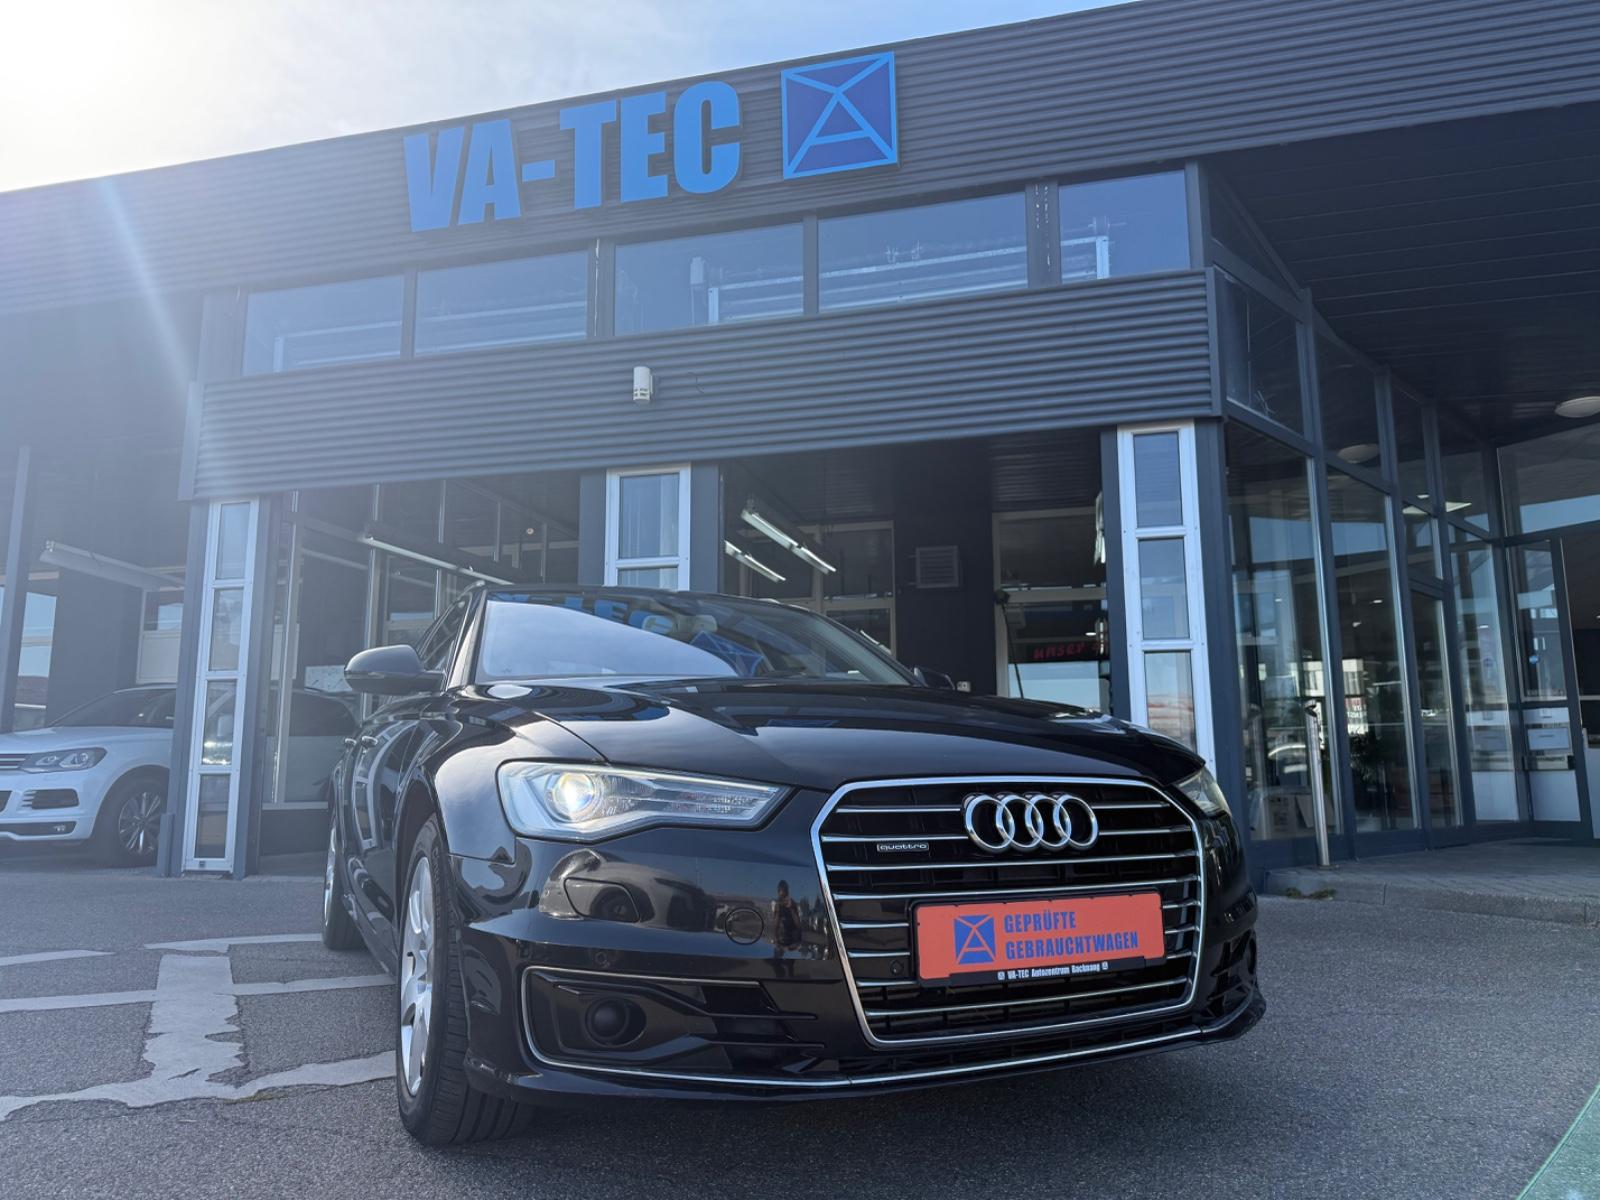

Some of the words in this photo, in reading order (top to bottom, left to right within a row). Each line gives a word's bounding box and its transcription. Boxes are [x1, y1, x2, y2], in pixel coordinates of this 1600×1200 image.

[404, 81, 740, 232] VA-TEC
[880, 843, 927, 851] quattro
[1004, 910, 1076, 933] GEPRÜFTE
[1005, 931, 1138, 960] GEBRAUCHTWAGEN
[1007, 969, 1029, 980] VA-TEC
[1031, 966, 1070, 977] Autozentrum
[1071, 963, 1100, 973] Backnang
